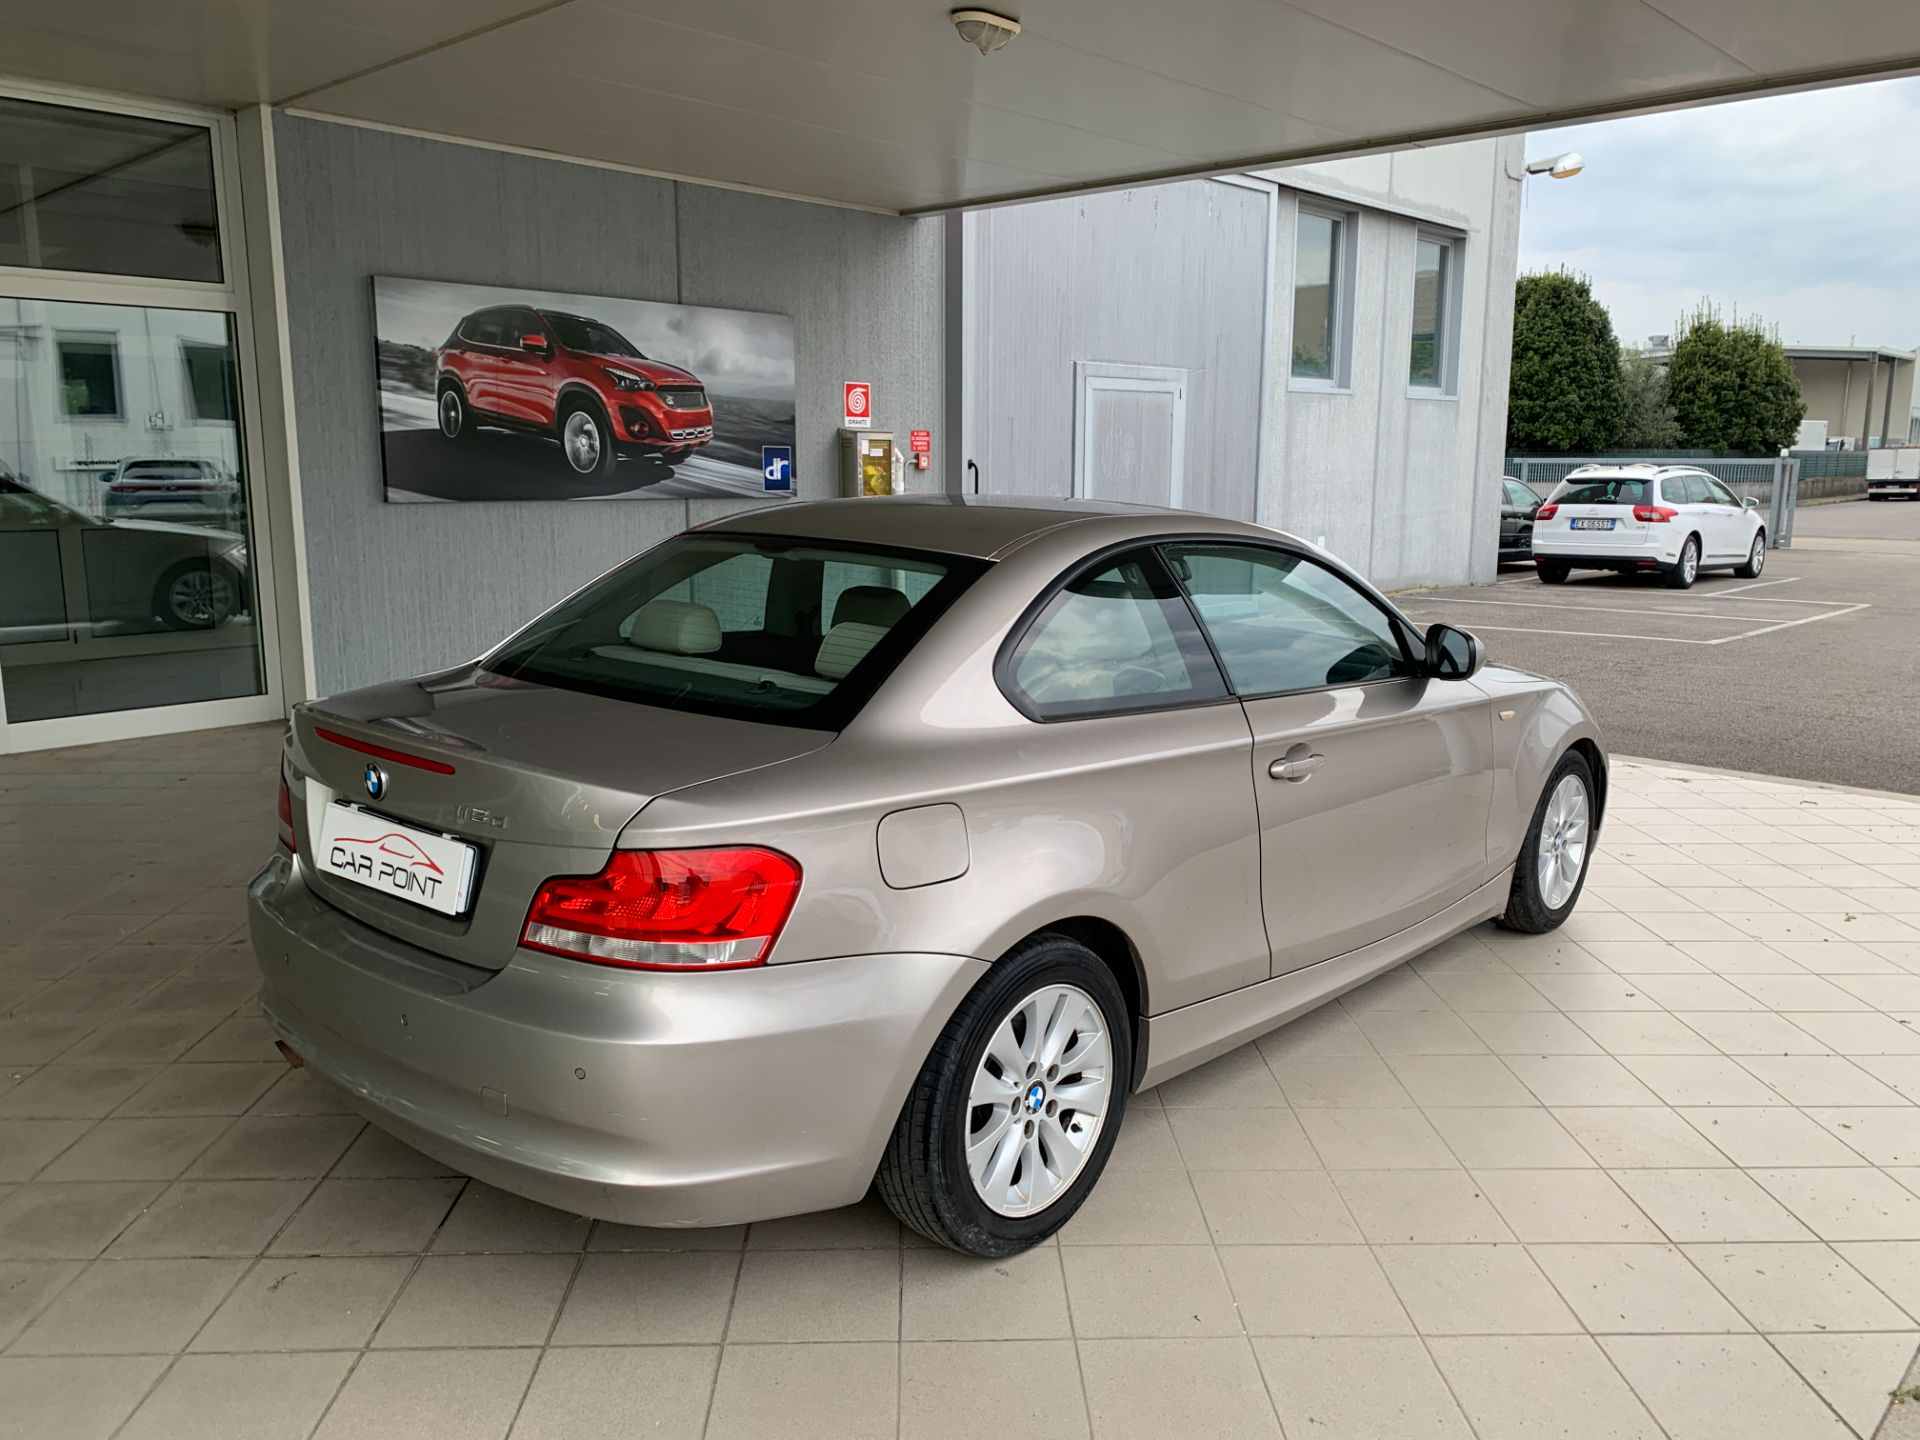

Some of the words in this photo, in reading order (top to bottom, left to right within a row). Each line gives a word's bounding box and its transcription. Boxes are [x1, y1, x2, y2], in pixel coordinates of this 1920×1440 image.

[765, 458, 789, 481] dr
[330, 846, 373, 878] CAR
[378, 861, 442, 899] POINT
